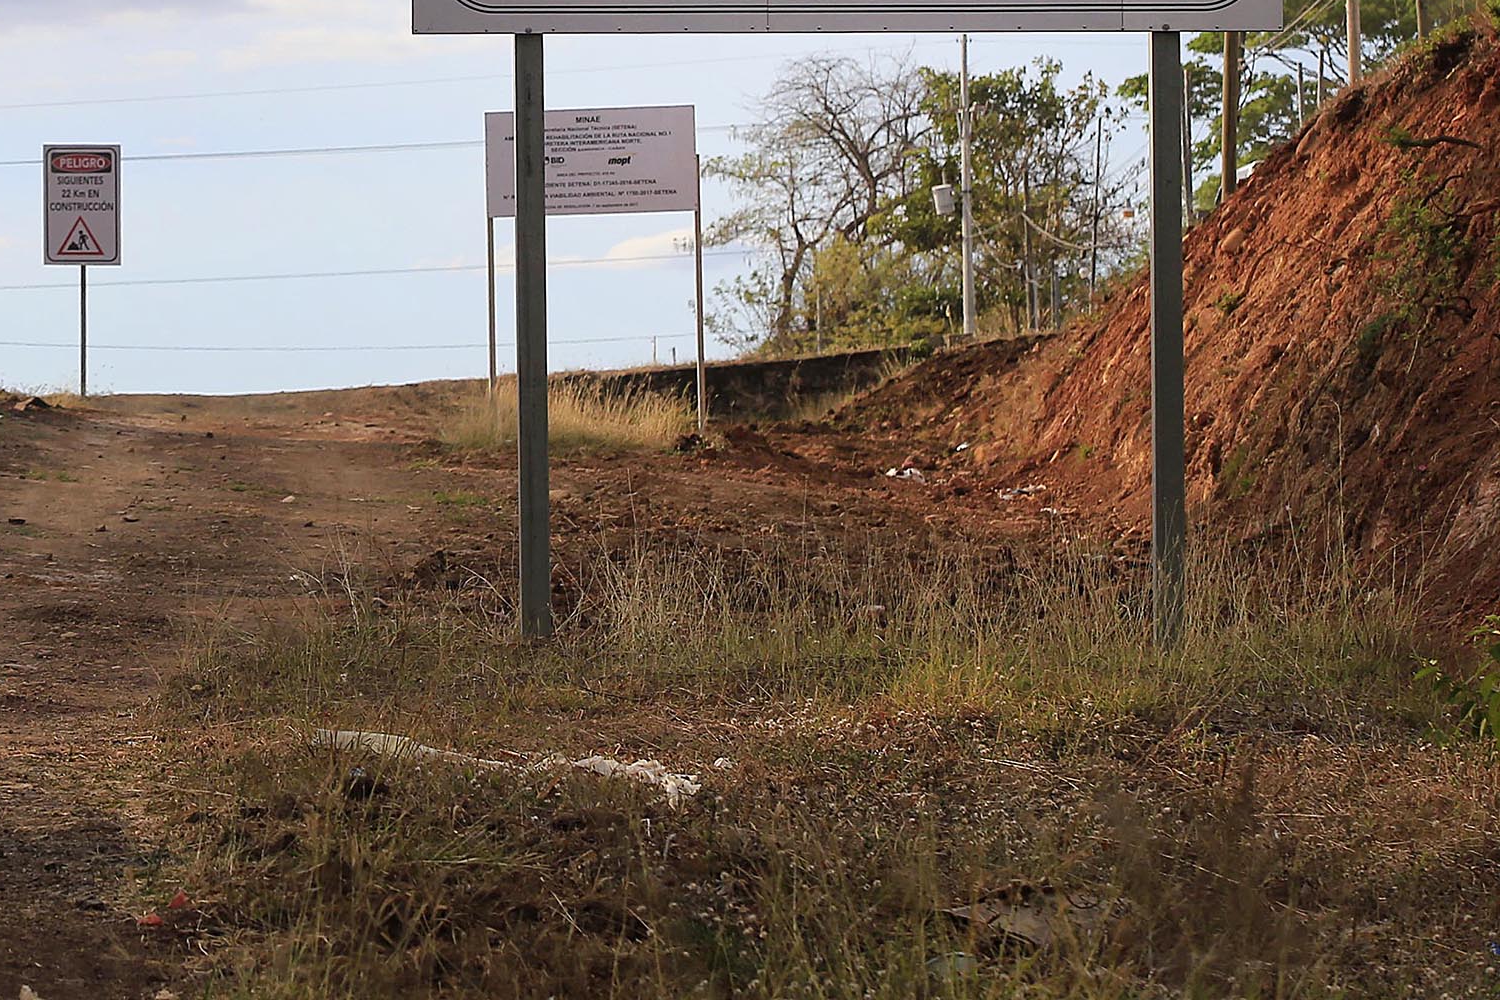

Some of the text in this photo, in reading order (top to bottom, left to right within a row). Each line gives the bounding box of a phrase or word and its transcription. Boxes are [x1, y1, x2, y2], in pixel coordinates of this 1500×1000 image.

[60, 158, 106, 168] PELIGRO
[608, 156, 631, 166] mopt
[57, 176, 104, 185] SIGUIENTES
[62, 189, 100, 198] 22 Km EN
[49, 201, 114, 211] CONSTRUCCIÓN
